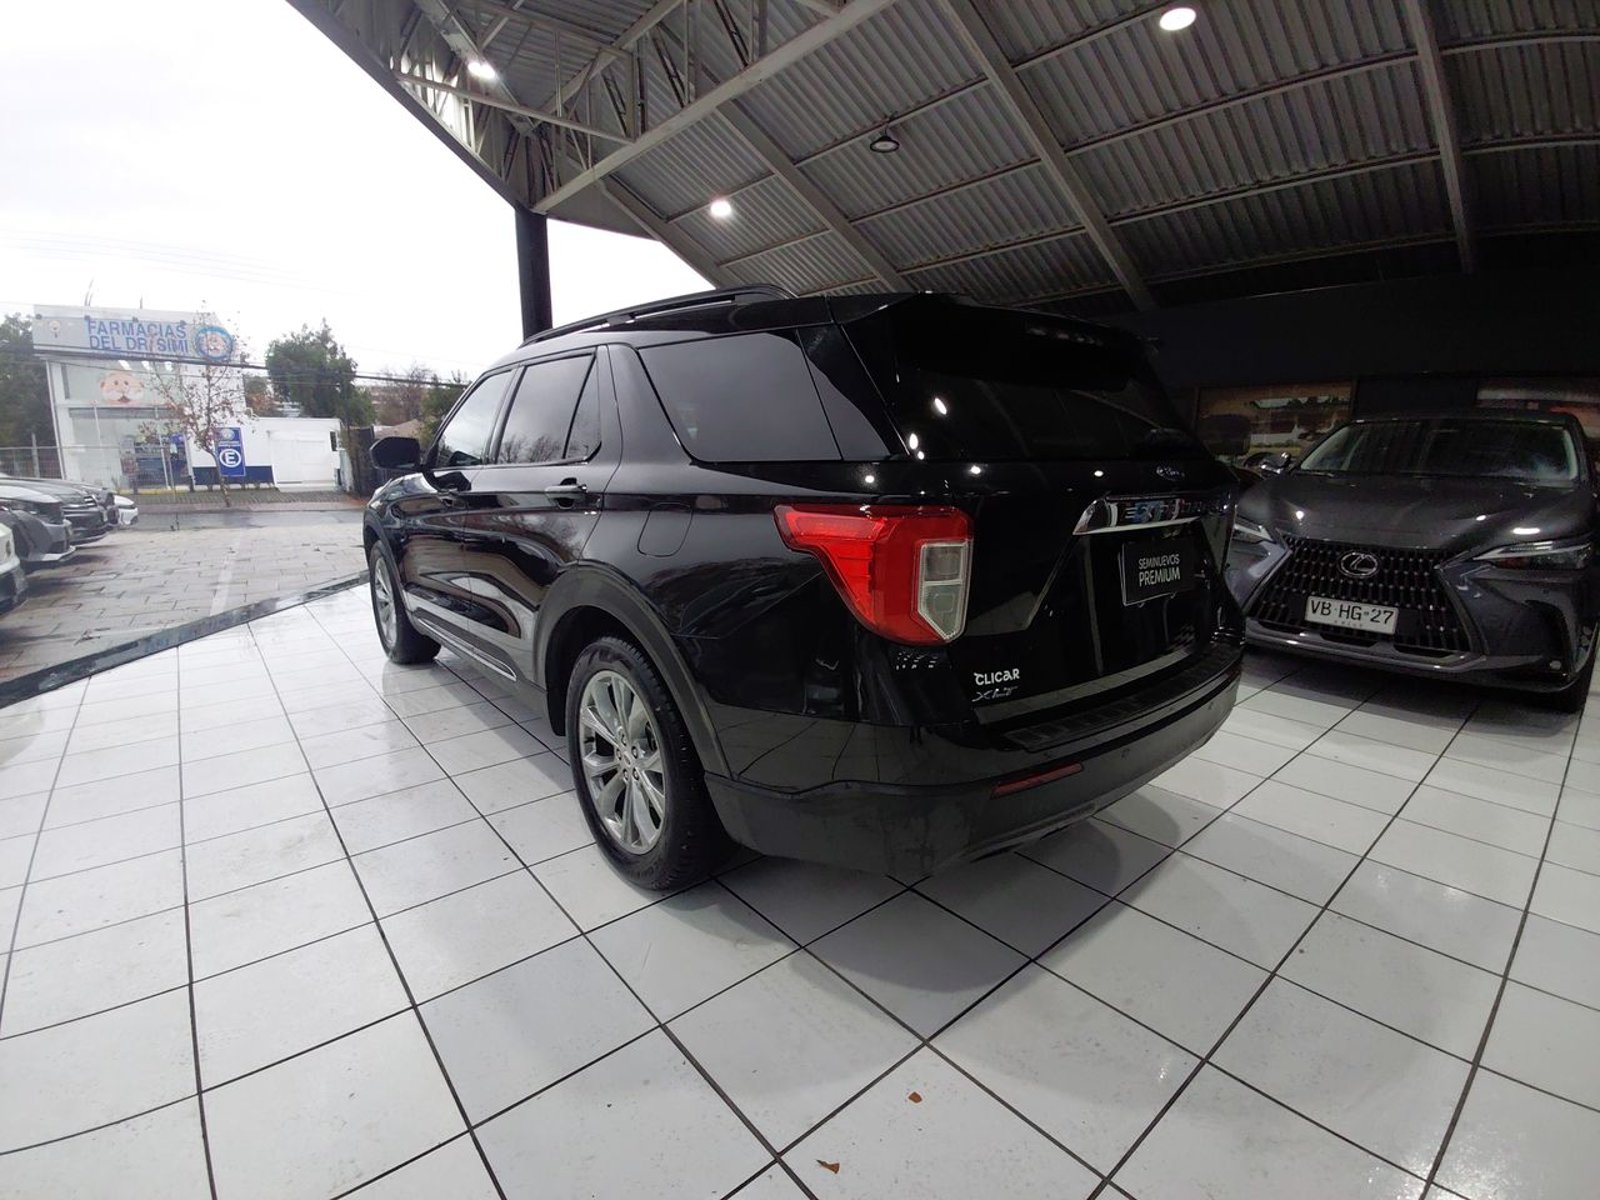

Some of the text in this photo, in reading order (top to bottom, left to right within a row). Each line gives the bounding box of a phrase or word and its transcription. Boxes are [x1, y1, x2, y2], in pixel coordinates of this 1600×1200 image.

[87, 320, 187, 339] FARMACIAS
[89, 335, 121, 351] DEL
[157, 338, 189, 353] SIMI
[1138, 554, 1181, 570] SEMINUEVOS
[1139, 566, 1181, 587] PREMIUM
